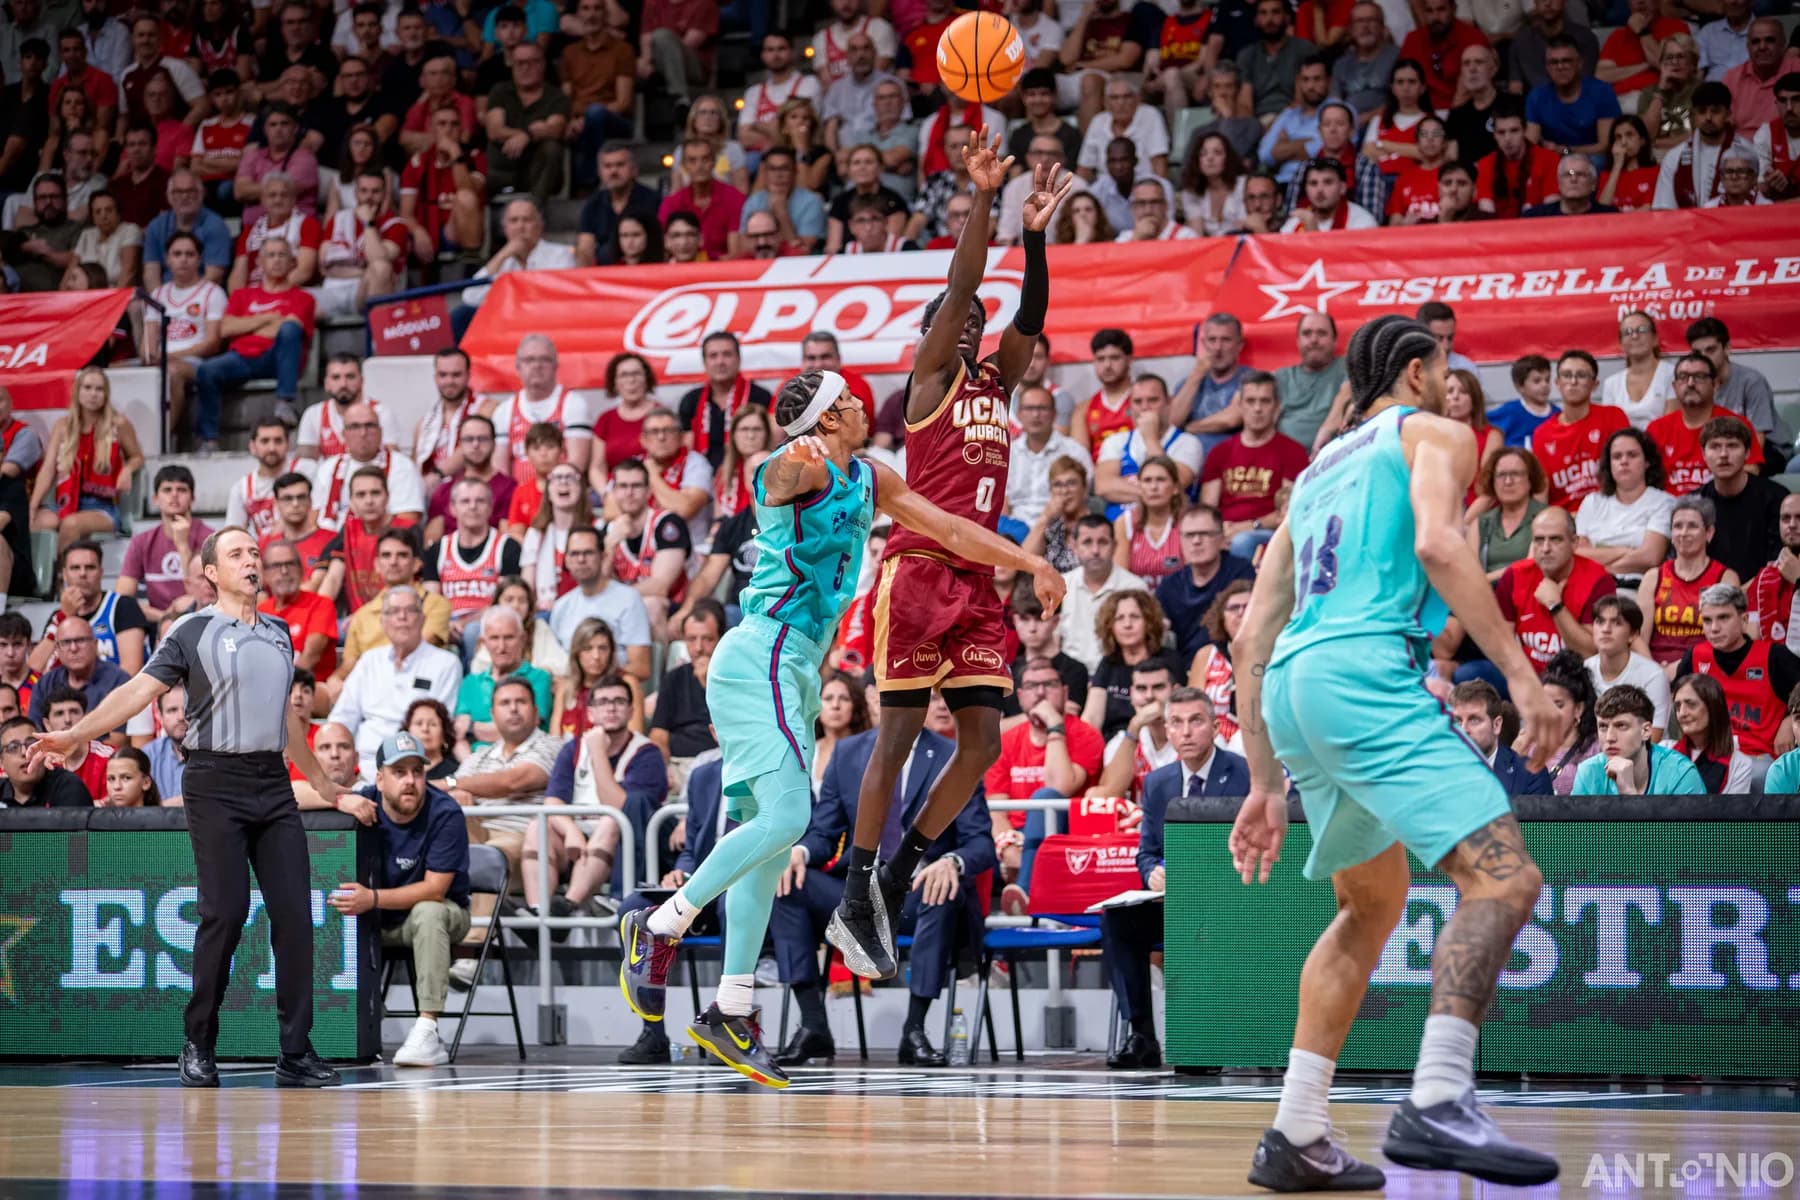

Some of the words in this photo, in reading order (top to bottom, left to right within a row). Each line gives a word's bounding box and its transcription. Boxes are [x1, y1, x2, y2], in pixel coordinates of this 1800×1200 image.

[1358, 262, 1671, 306] ESTRELLA
[1685, 266, 1725, 282] DE
[1729, 256, 1800, 287] LE
[1609, 288, 1695, 303] MURCIA
[964, 424, 1009, 447] MURCIA
[975, 476, 996, 513] 0
[833, 551, 852, 592] 5
[442, 580, 497, 599] UCAM
[1655, 605, 1703, 624] CA
[1522, 631, 1566, 653] UCA
[1729, 703, 1761, 725] AM
[1369, 884, 1800, 989] ESTR
